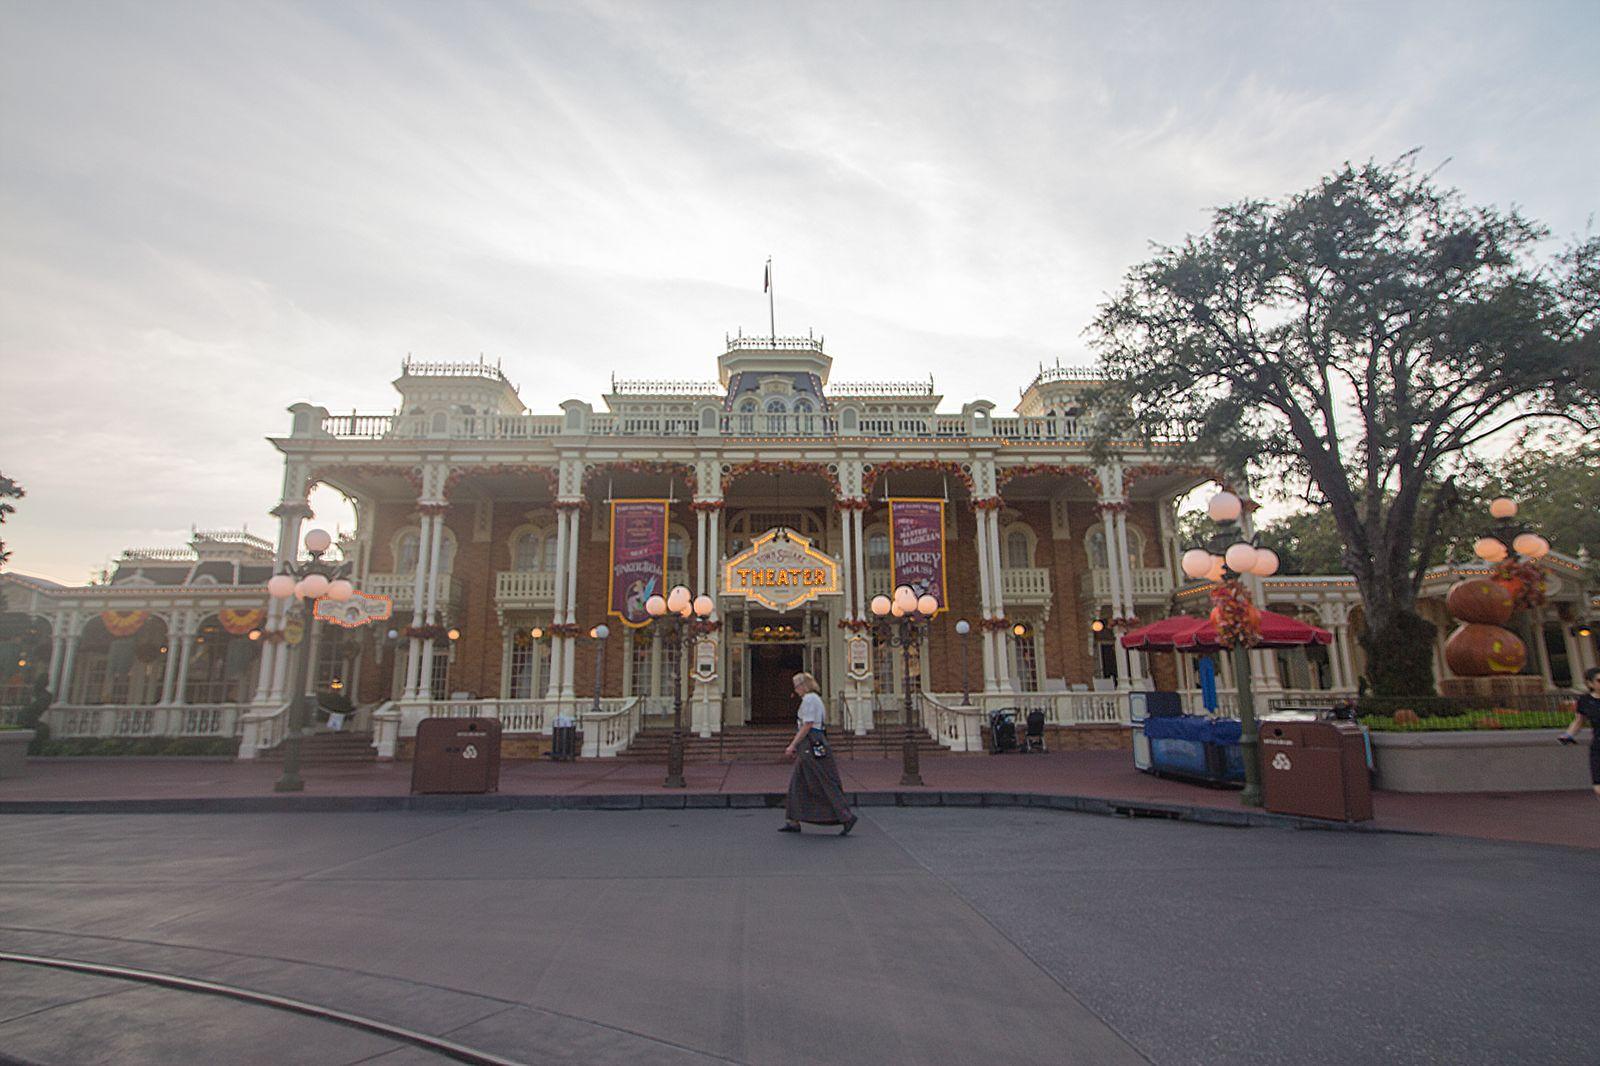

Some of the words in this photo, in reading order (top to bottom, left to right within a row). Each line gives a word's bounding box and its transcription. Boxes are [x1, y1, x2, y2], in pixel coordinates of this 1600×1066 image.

[895, 552, 941, 568] MICKEY
[737, 567, 826, 587] THEATER
[902, 564, 933, 576] MOUSE
